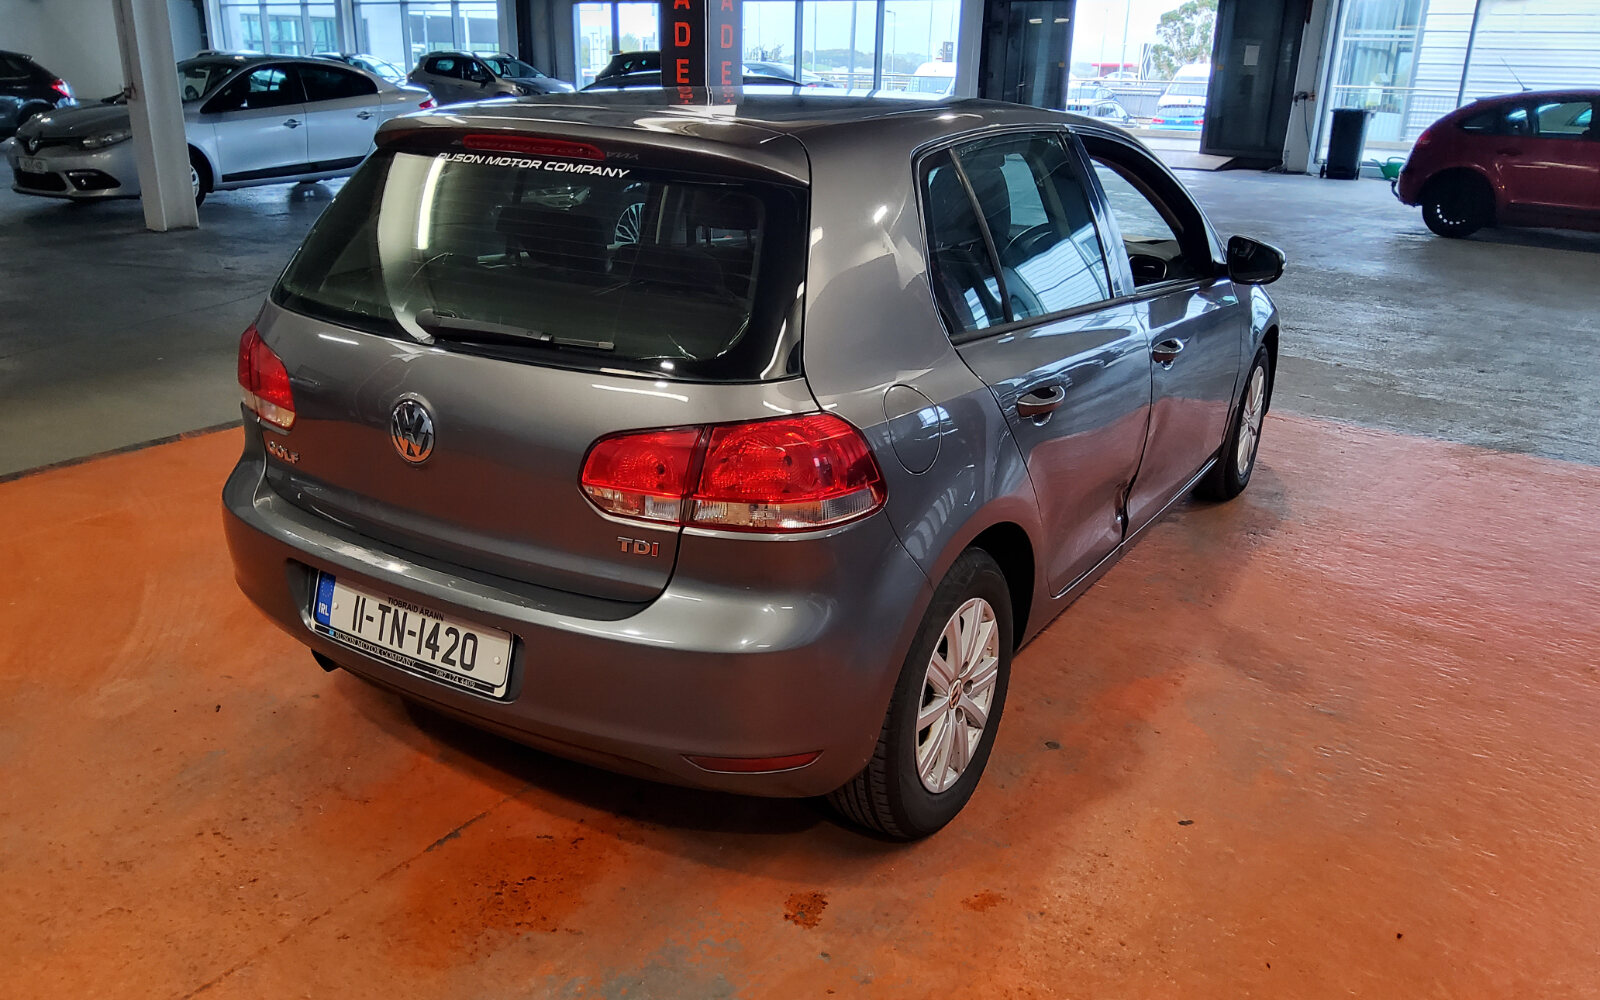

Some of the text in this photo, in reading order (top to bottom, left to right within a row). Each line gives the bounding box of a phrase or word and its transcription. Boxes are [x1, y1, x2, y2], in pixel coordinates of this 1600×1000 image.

[485, 156, 543, 170] MOTOR
[544, 161, 630, 179] COMPANY
[268, 440, 300, 464] GOLF
[617, 536, 659, 557] TDI
[318, 601, 330, 617] IRL
[388, 597, 419, 613] TIOBRAID
[352, 595, 479, 672] 11-TN-1420
[380, 649, 416, 667] COMPANY
